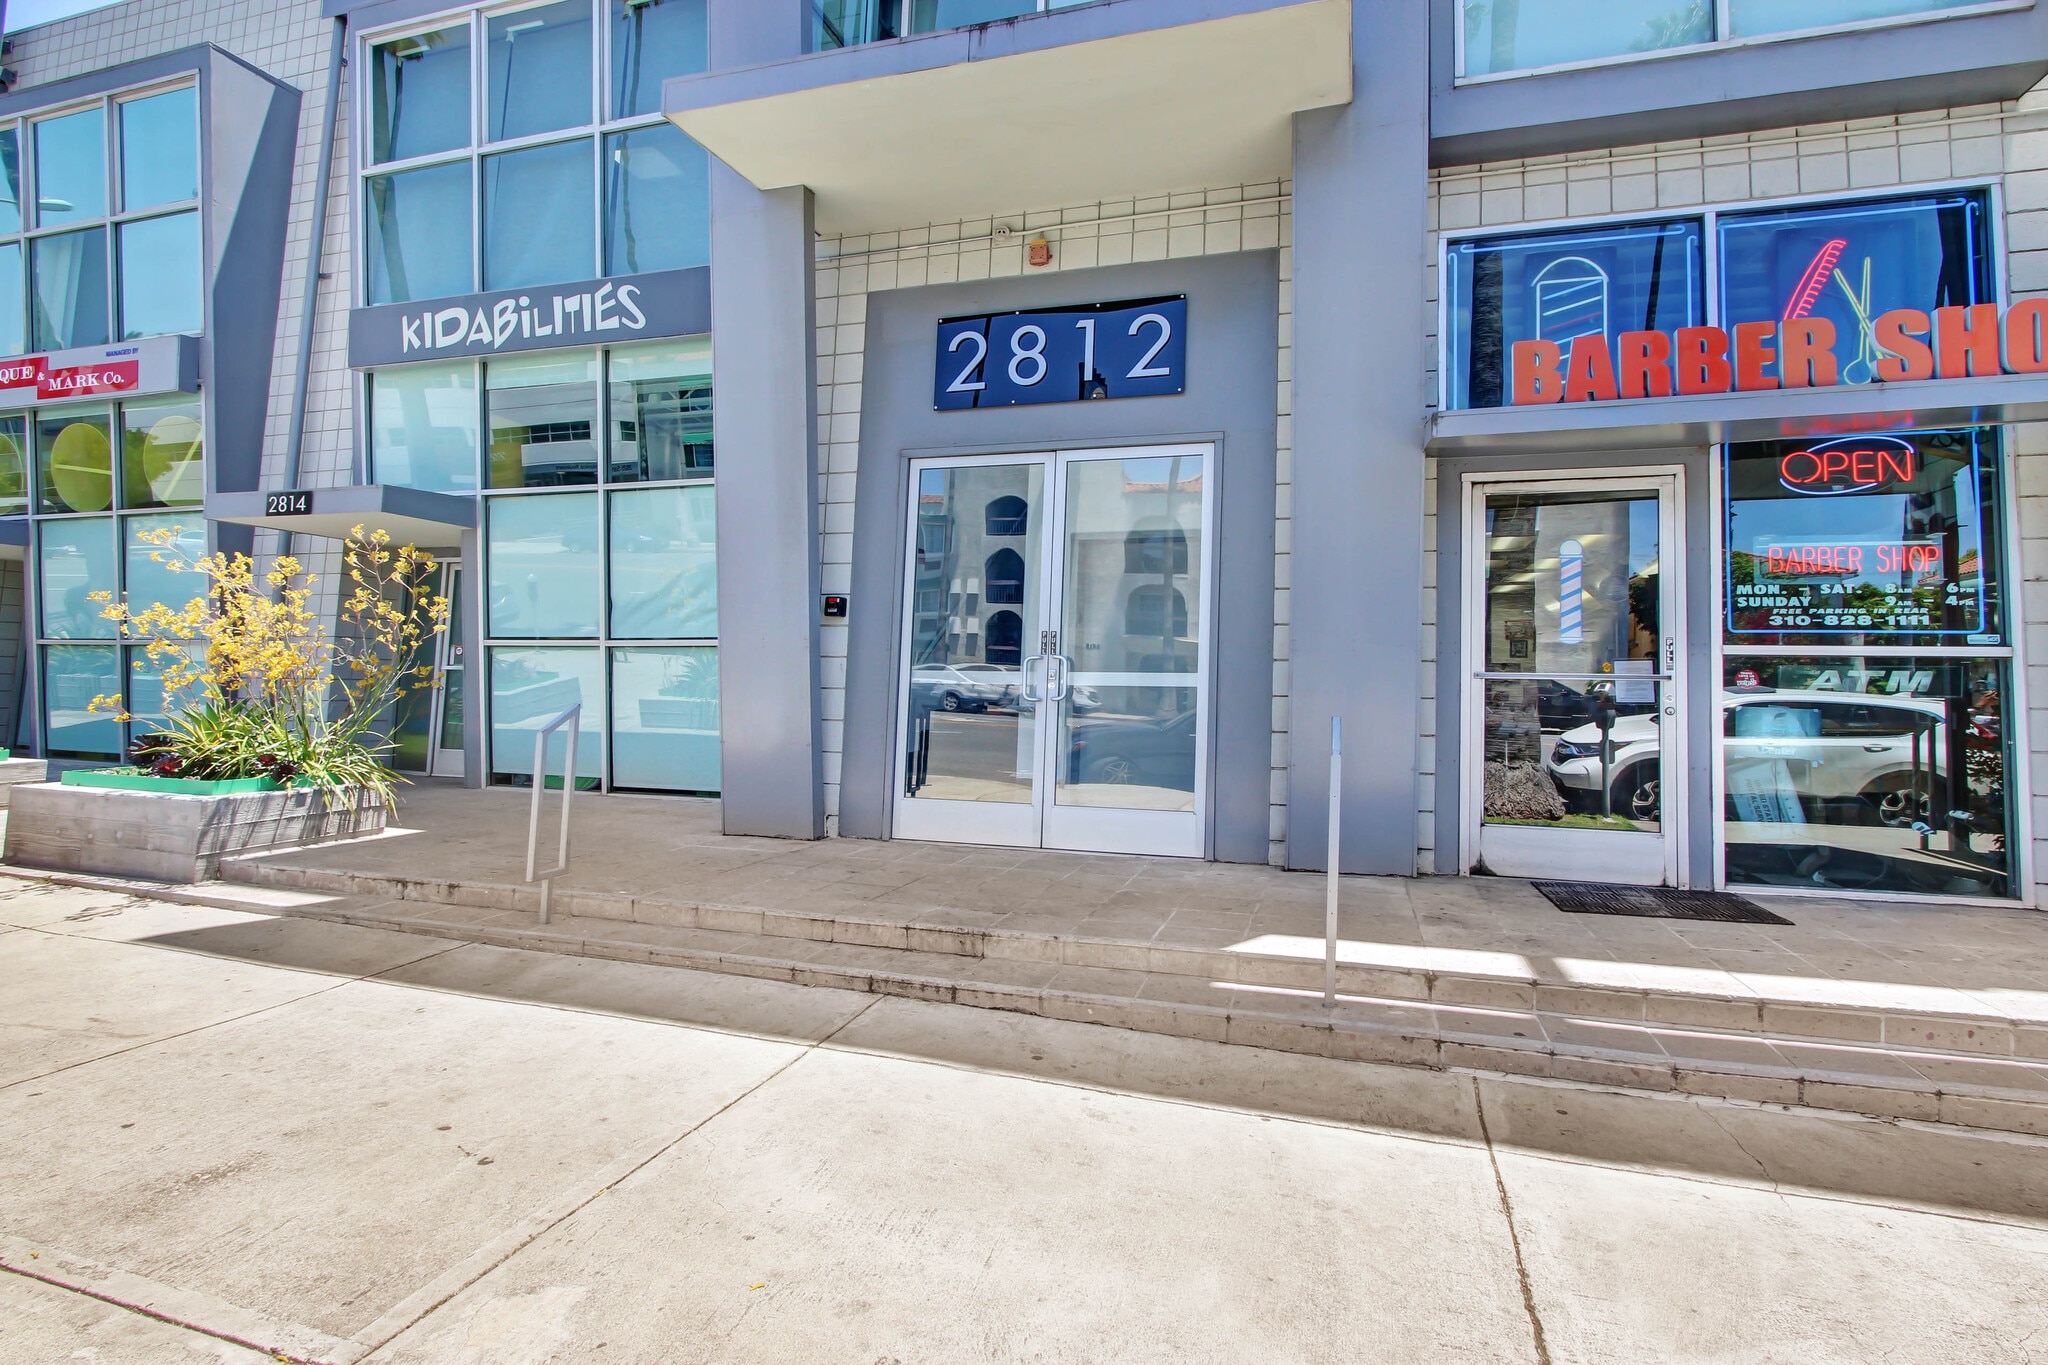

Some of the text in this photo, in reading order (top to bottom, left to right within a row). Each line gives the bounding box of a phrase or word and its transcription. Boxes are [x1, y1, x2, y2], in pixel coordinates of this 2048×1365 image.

[106, 349, 131, 357] MANAGED
[946, 313, 1171, 392] 2812
[1511, 297, 2048, 406] BARBER SHO
[37, 371, 46, 381] &
[48, 372, 100, 391] MARK
[103, 371, 125, 385] Co.
[1781, 450, 1913, 483] OPEN
[268, 495, 307, 513] 2814
[1767, 544, 1941, 573] BARBER SHOP
[1736, 584, 1788, 595] MON.
[1820, 583, 1863, 594] SAT.
[1737, 596, 1812, 607] SUNDAY
[1768, 614, 1930, 626] 310-828-1111
[1806, 670, 1933, 692] ATM
